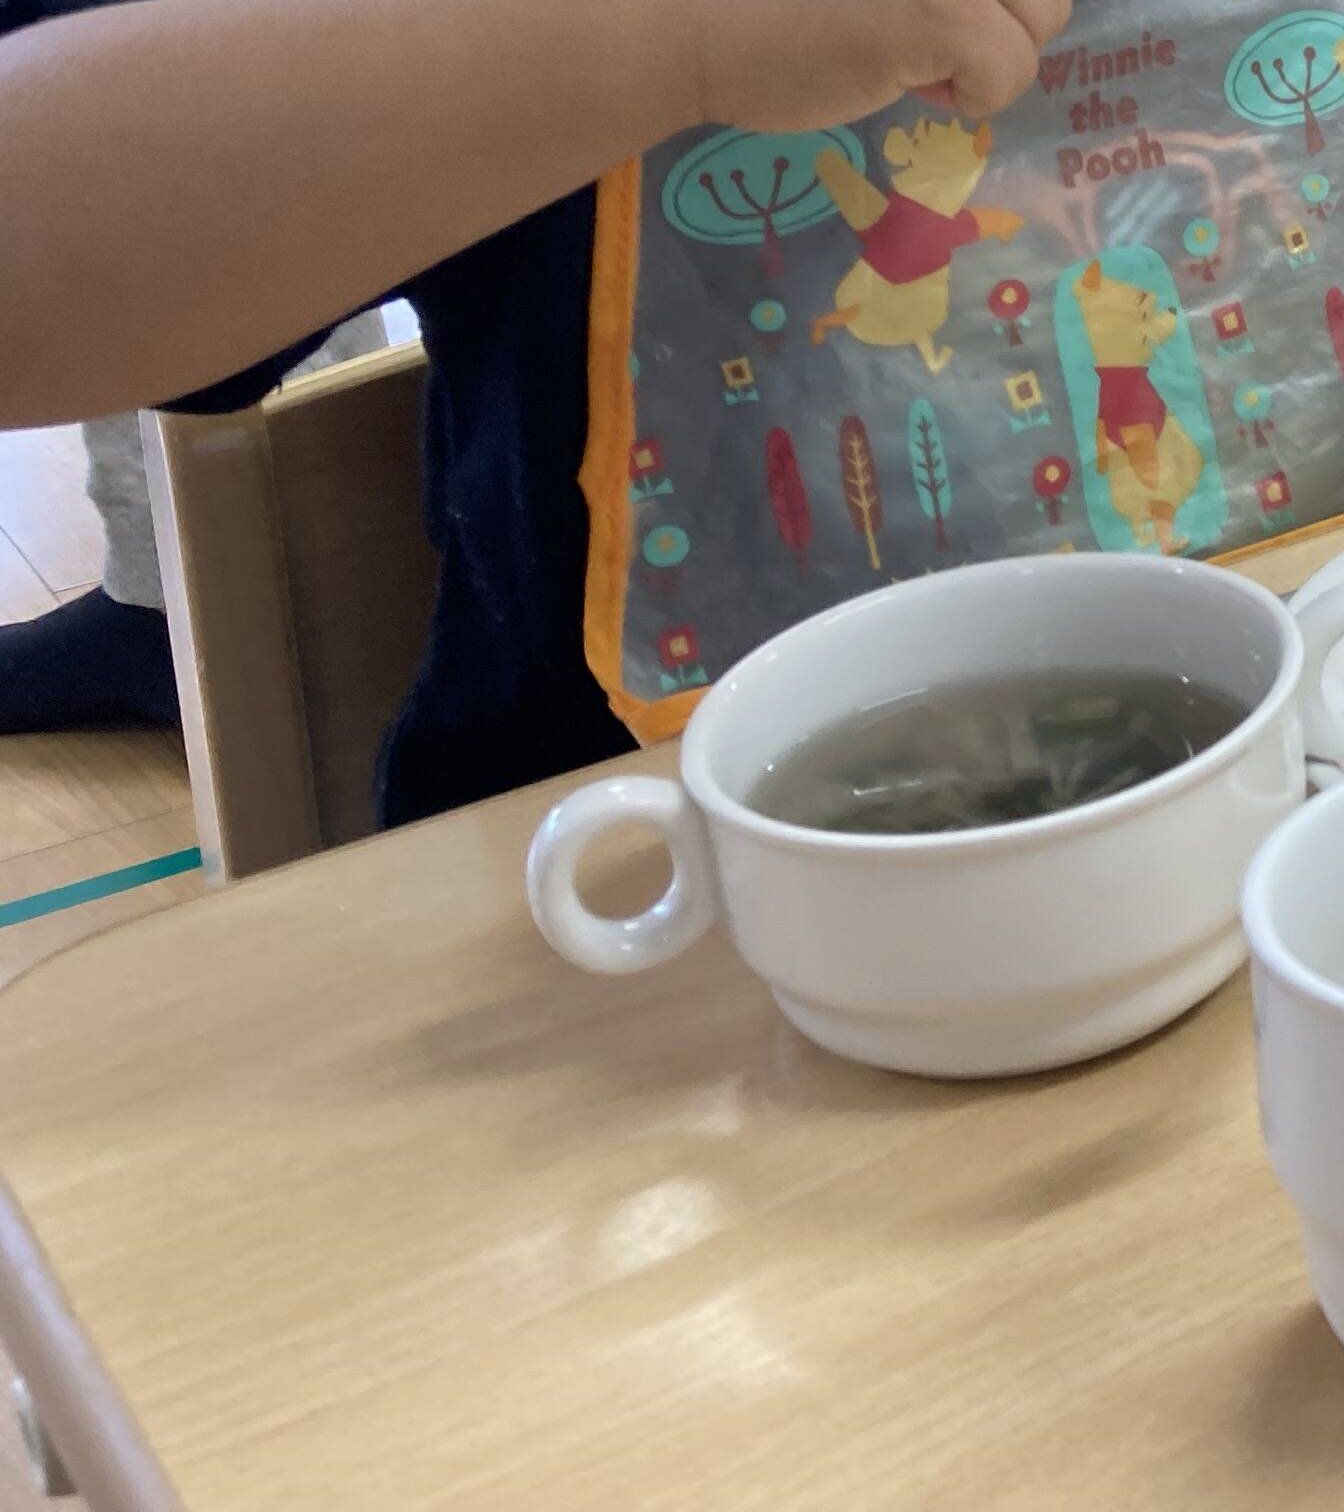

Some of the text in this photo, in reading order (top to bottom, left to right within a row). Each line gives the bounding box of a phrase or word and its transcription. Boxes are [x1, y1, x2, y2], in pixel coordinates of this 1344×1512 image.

[1038, 30, 1177, 96] Winnie
[1069, 90, 1139, 135] the
[1057, 129, 1166, 189] Pooh
